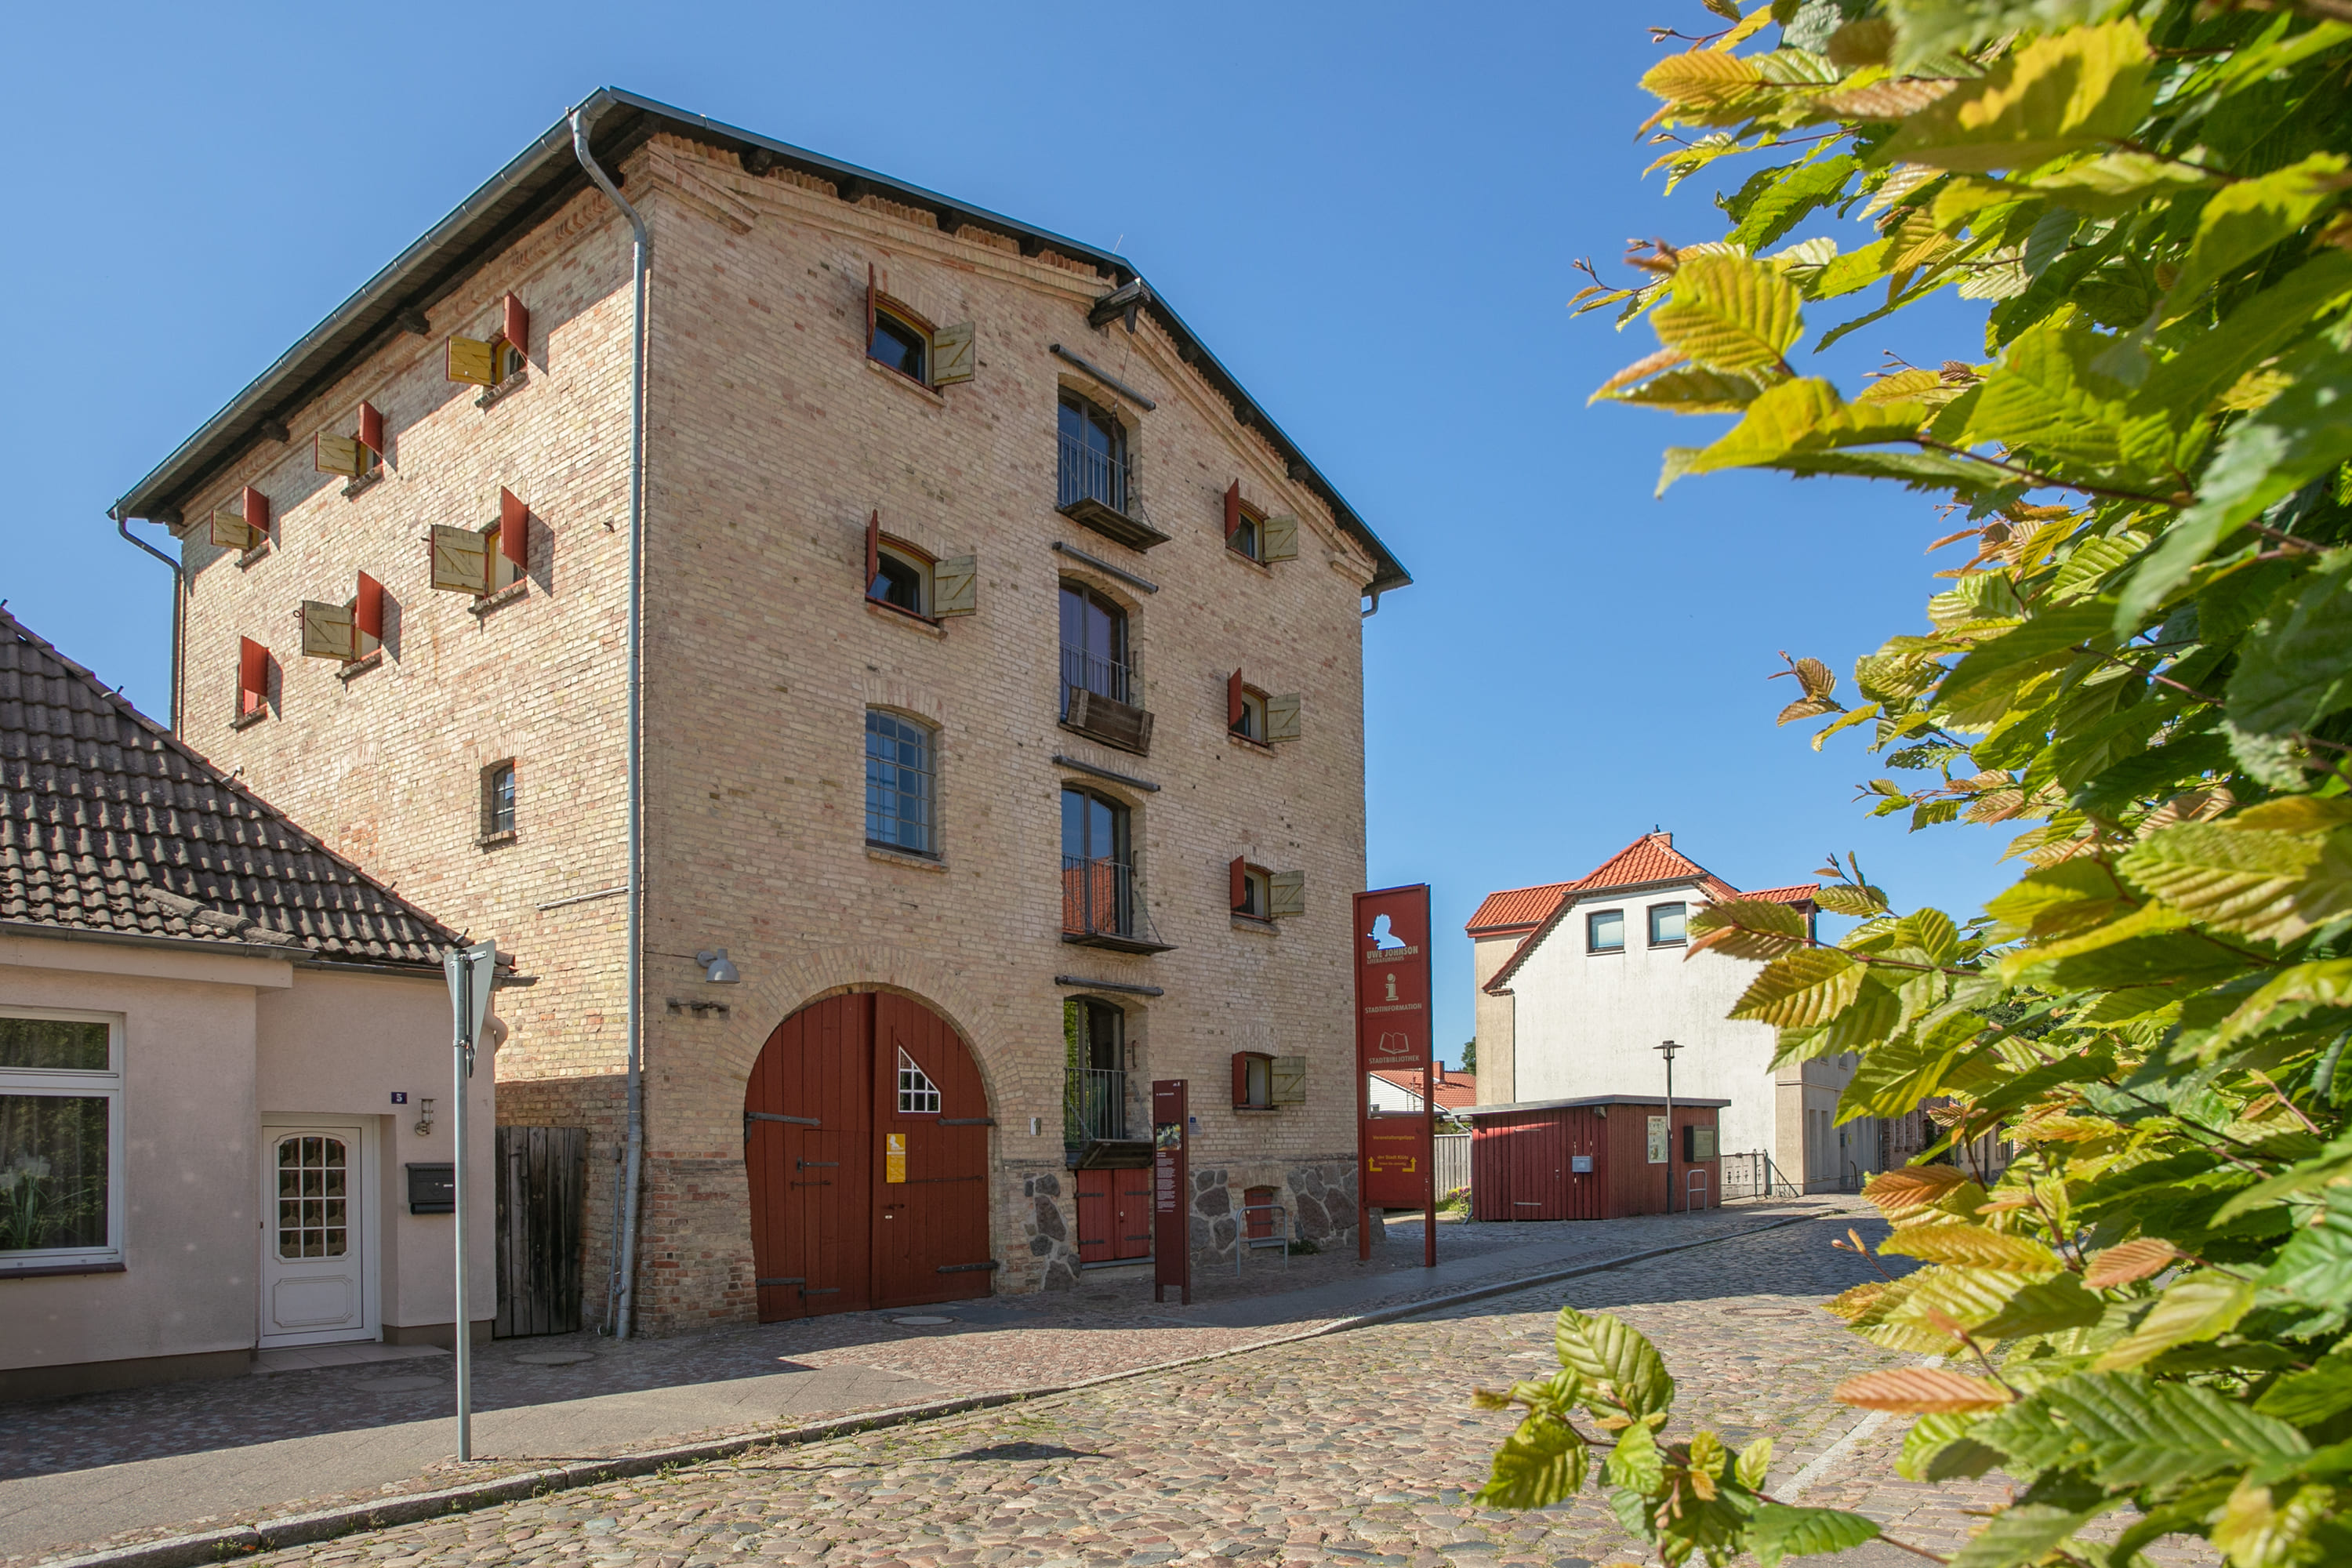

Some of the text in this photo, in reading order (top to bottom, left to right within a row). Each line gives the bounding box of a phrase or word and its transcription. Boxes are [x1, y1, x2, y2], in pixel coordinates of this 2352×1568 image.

[1367, 946, 1418, 960] UWE JOHNSON
[1367, 956, 1405, 964] LITERATURHAUS
[1365, 1003, 1422, 1014] STADTINFORMATION
[1369, 1054, 1420, 1065] STADTBIBLIOTHEK
[397, 1093, 402, 1102] 5
